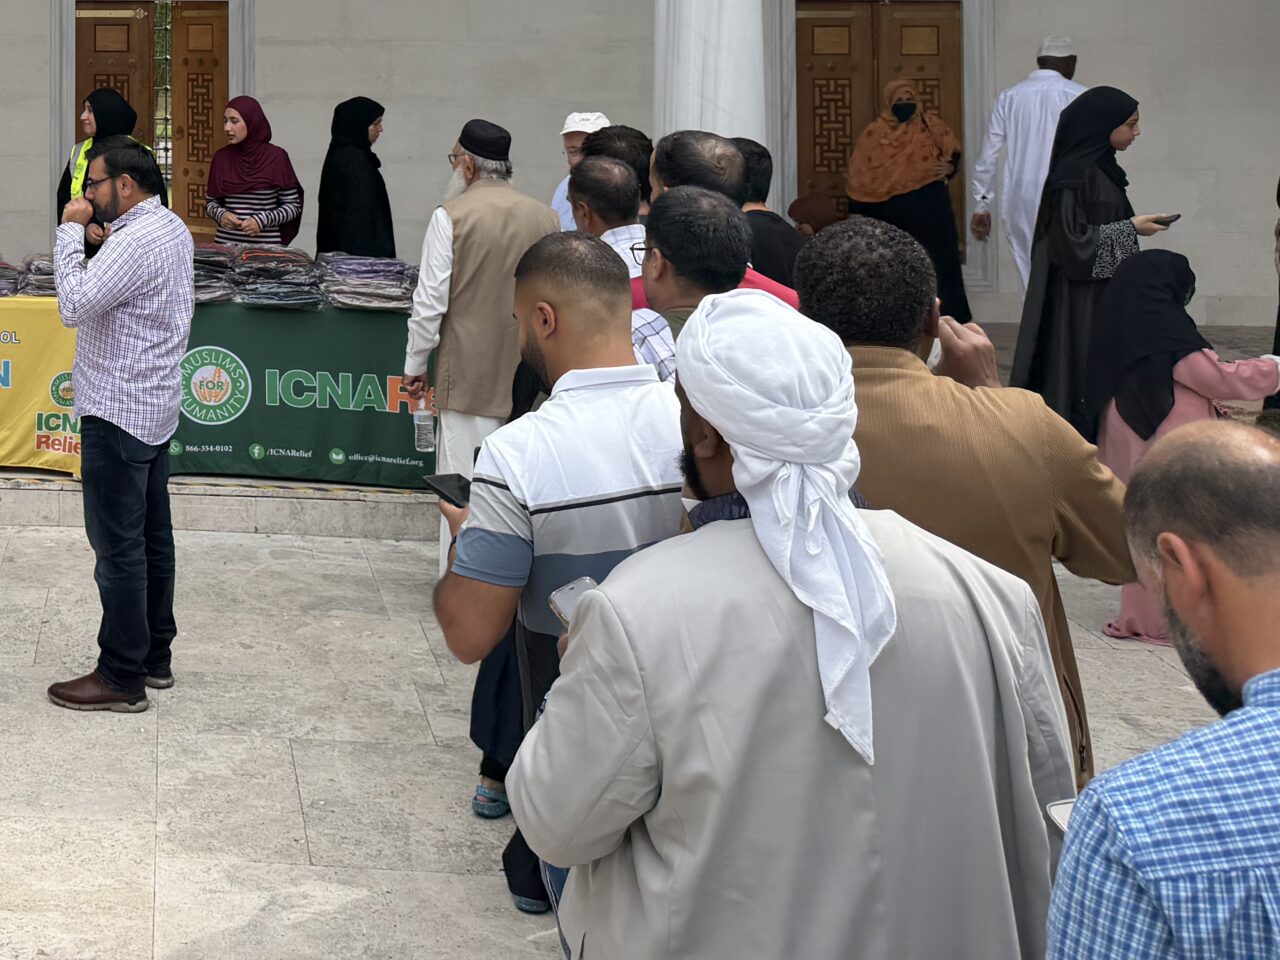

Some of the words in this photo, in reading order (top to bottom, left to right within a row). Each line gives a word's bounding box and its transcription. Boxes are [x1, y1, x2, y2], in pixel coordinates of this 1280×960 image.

[181, 351, 243, 378] MUSLIMS
[199, 380, 225, 391] FOR
[36, 411, 81, 435] ICN
[348, 453, 424, 468] office@icnarelief.org
